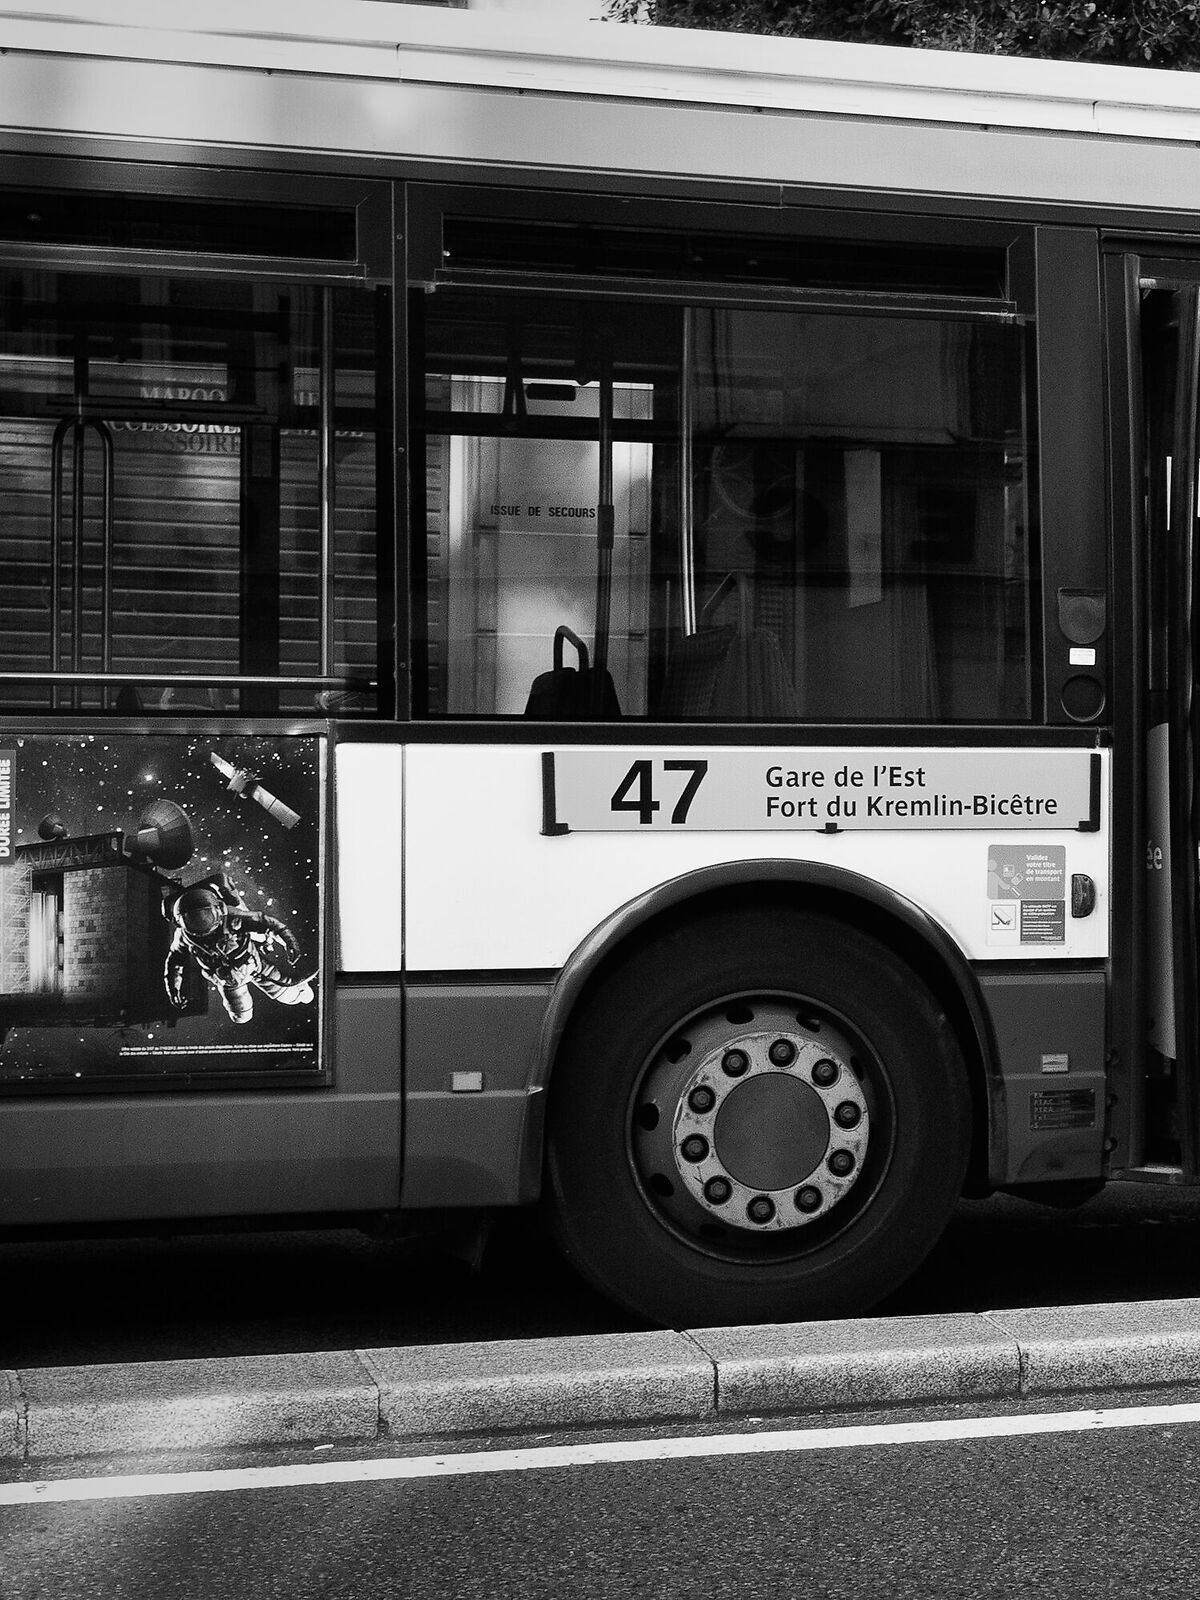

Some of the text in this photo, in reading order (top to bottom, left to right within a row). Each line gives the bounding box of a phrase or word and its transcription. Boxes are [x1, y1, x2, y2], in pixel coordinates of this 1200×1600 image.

[490, 505, 596, 518] ISSUE DE SECOURS
[766, 766, 825, 788] Gare
[834, 766, 864, 788] de
[611, 761, 708, 825] 47
[766, 793, 1058, 818] Fort du Kremlin-Bicêtre
